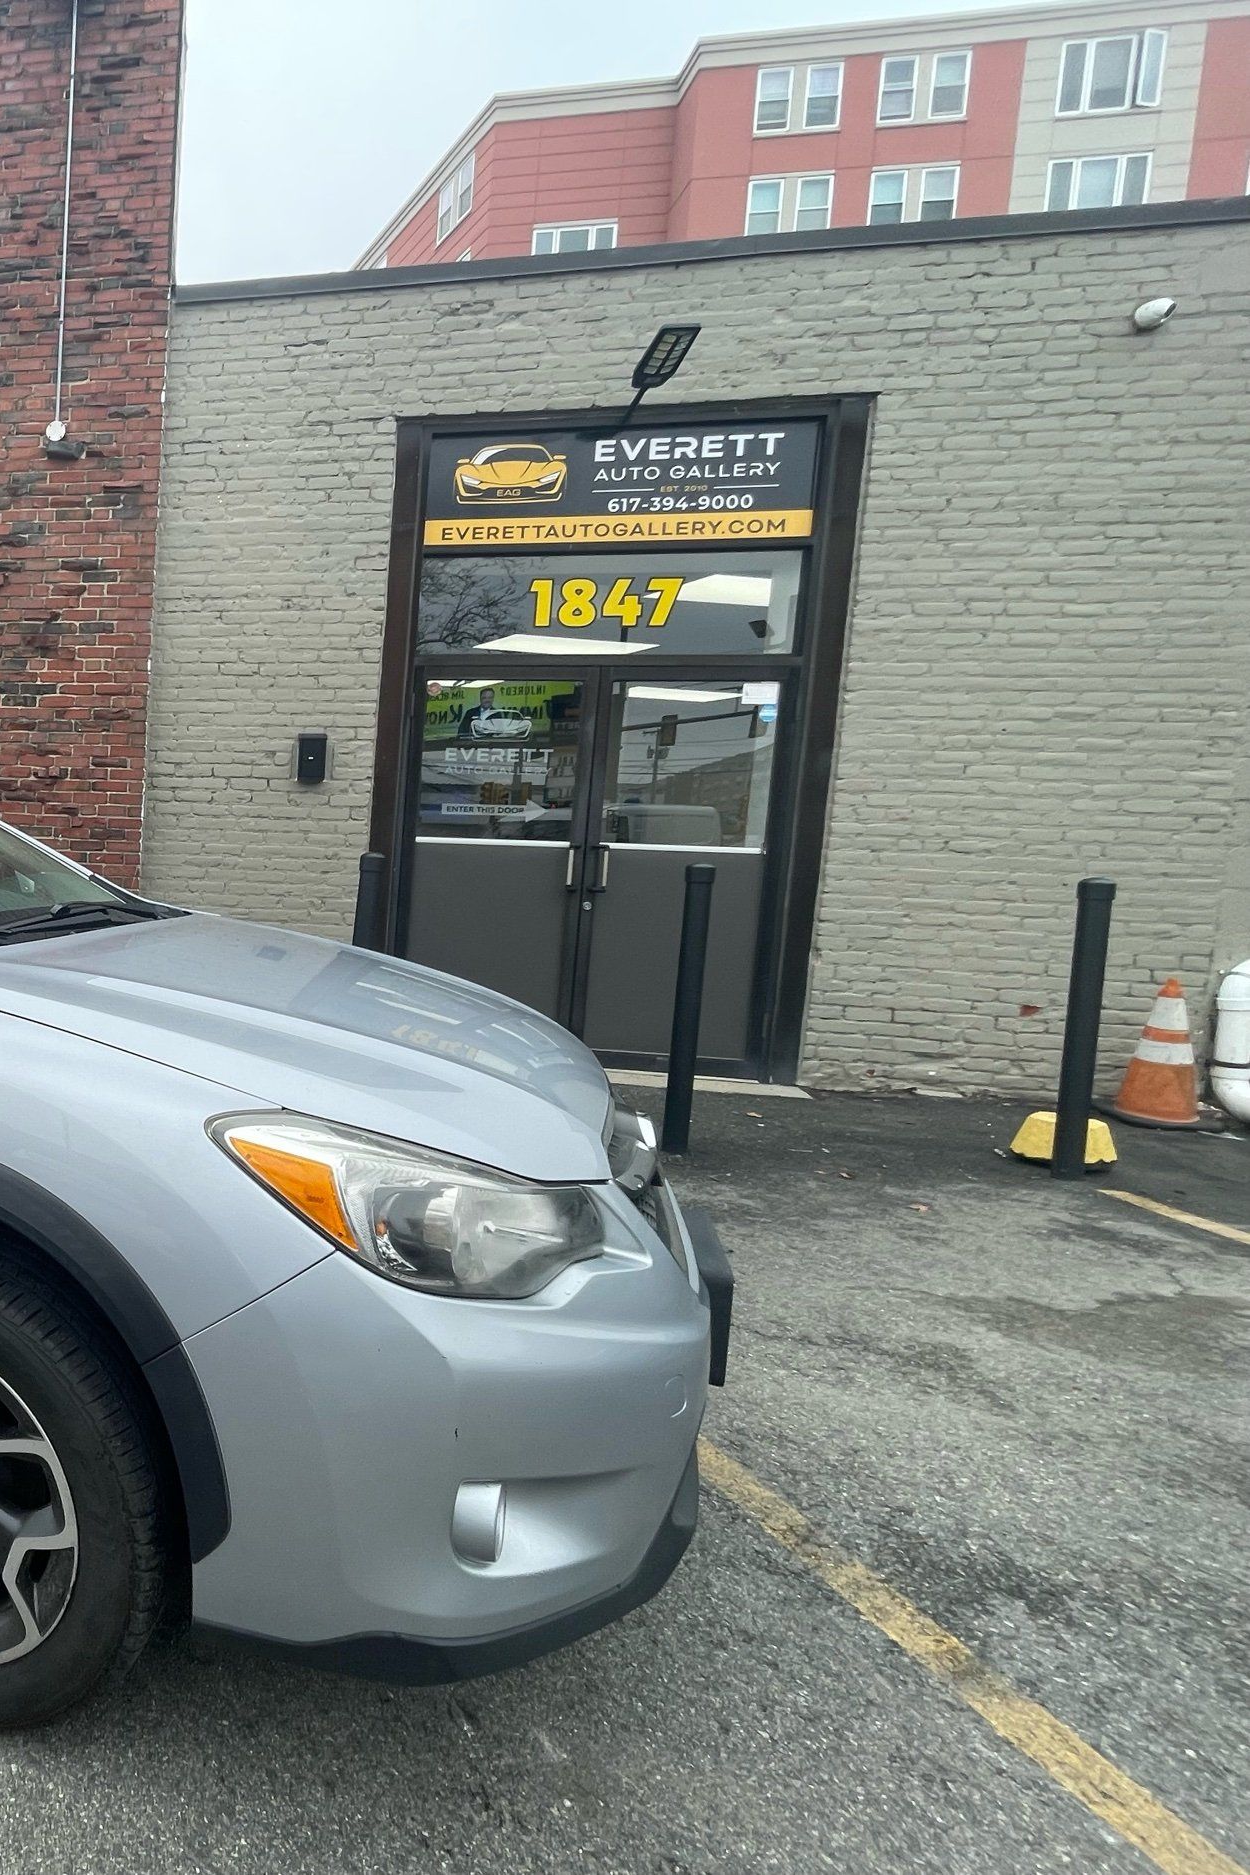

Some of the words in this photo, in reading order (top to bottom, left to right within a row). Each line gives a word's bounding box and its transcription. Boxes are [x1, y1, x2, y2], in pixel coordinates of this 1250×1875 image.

[593, 432, 785, 462] EVERETT
[594, 466, 660, 482] AUTO
[669, 461, 781, 479] GALLERY
[496, 489, 521, 498] EAG
[684, 484, 708, 492] 2010
[607, 494, 753, 513] 617-394-9000
[441, 518, 787, 542] EVERETTAUTOGALLERY.COM
[529, 577, 685, 628] 1847
[445, 747, 554, 763] EVERETT
[445, 765, 483, 775] AUTO
[446, 806, 473, 814] ENTER
[476, 806, 495, 814] THIS
[497, 806, 525, 814] DOOR
